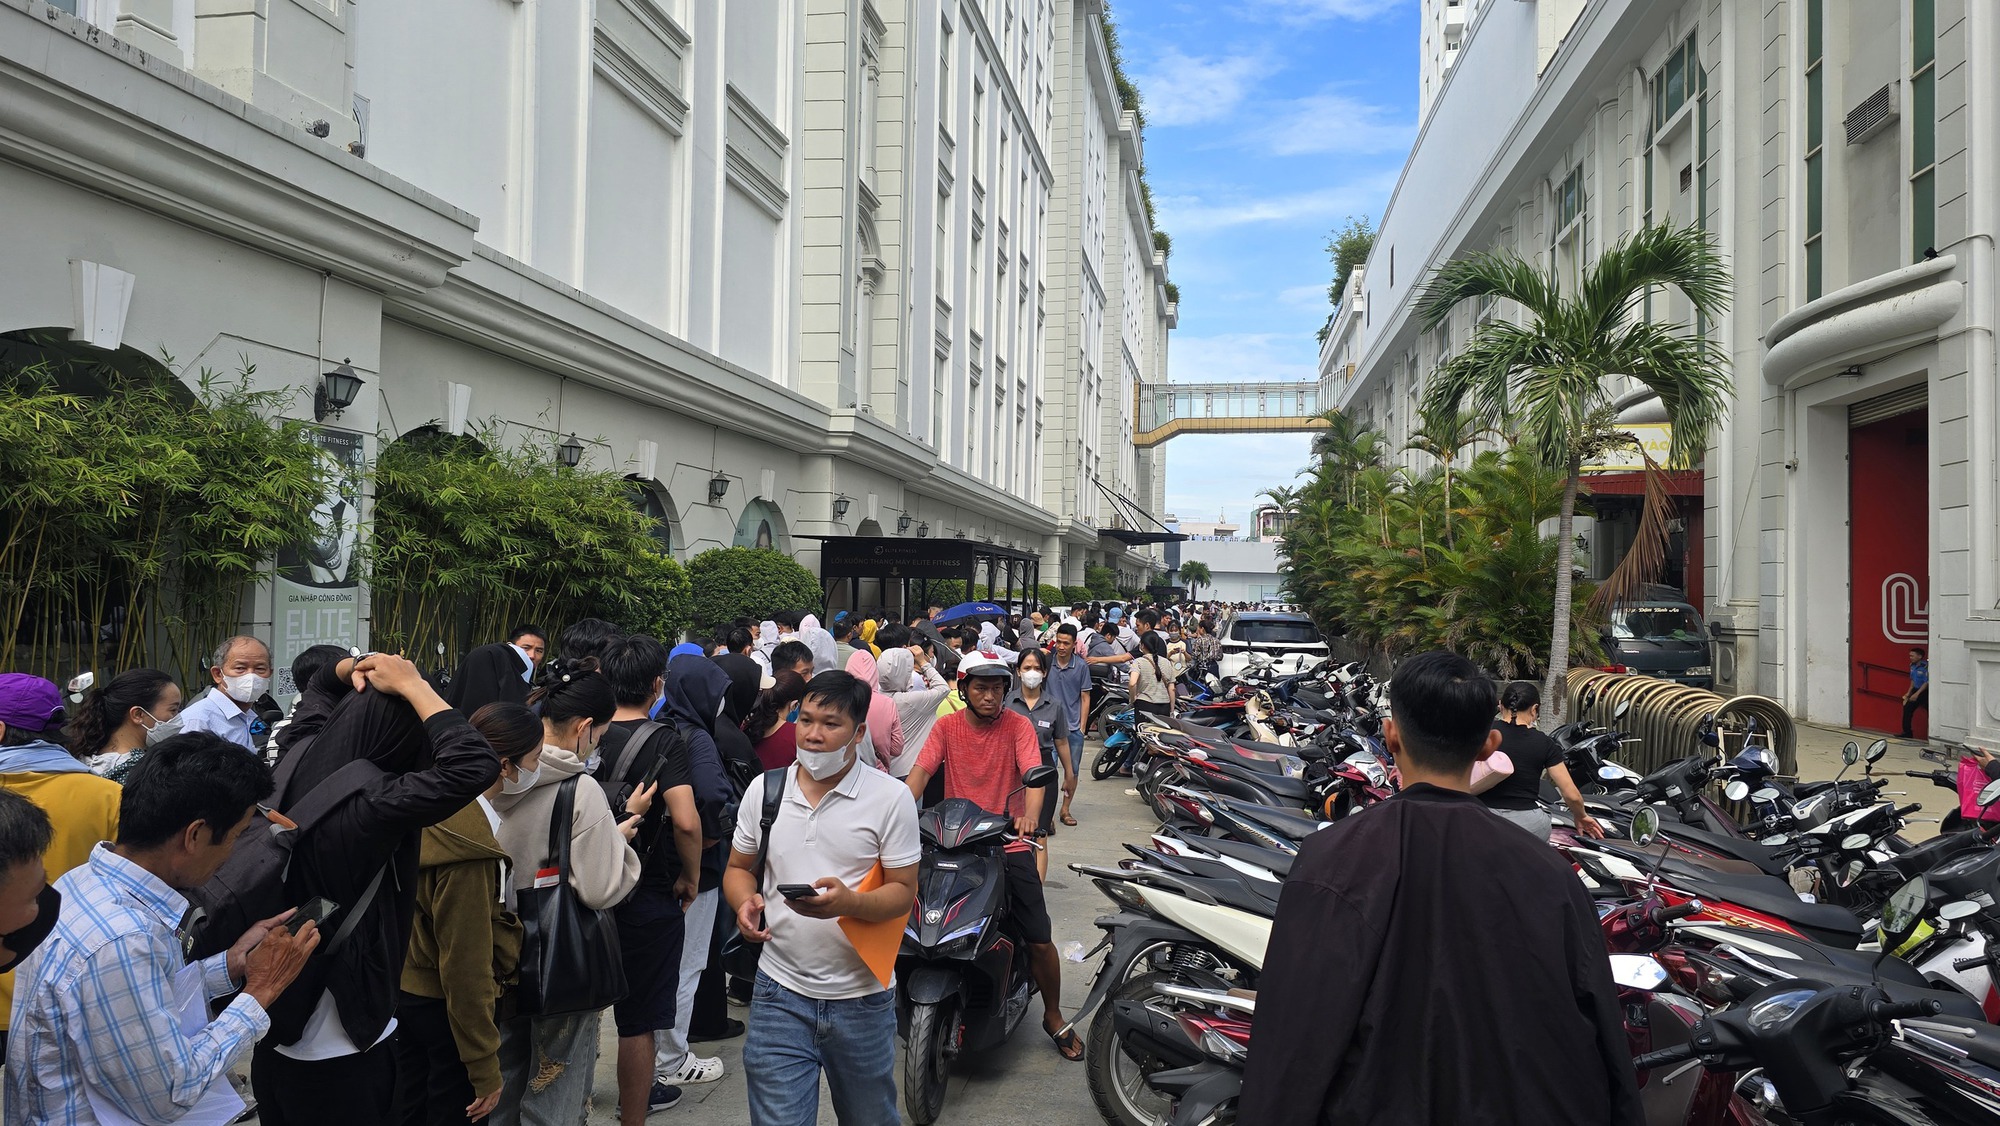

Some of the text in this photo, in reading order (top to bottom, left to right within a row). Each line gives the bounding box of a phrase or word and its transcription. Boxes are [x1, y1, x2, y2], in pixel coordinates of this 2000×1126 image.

[328, 436, 349, 446] FITNESS
[288, 593, 352, 604] GIA NHẬP CỘNG ĐỒNG
[286, 608, 351, 640] ELITE
